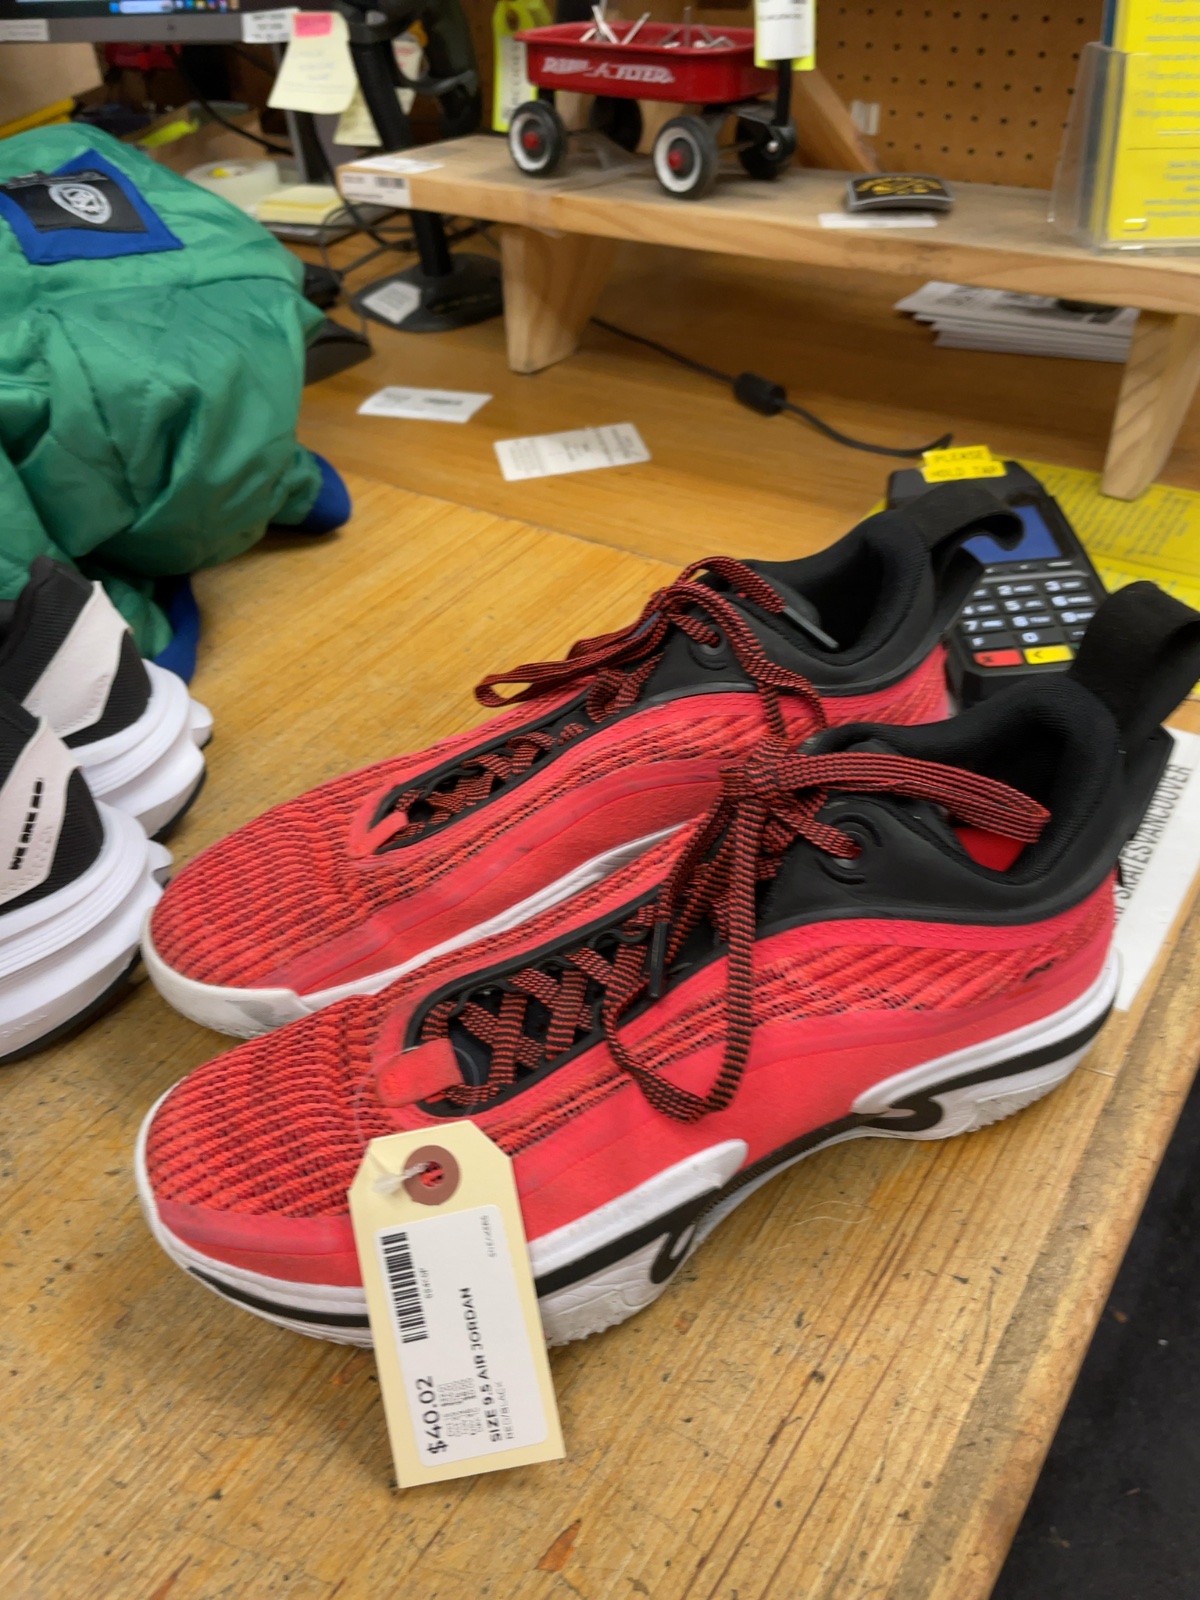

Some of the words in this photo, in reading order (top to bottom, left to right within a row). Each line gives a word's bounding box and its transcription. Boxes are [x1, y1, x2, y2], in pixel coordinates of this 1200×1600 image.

[459, 1286, 483, 1351] JORDAN
[474, 1353, 489, 1381] AIR
[480, 1383, 494, 1406] 9.5
[414, 1375, 447, 1455] $40.02
[486, 1408, 502, 1442] SIZE
